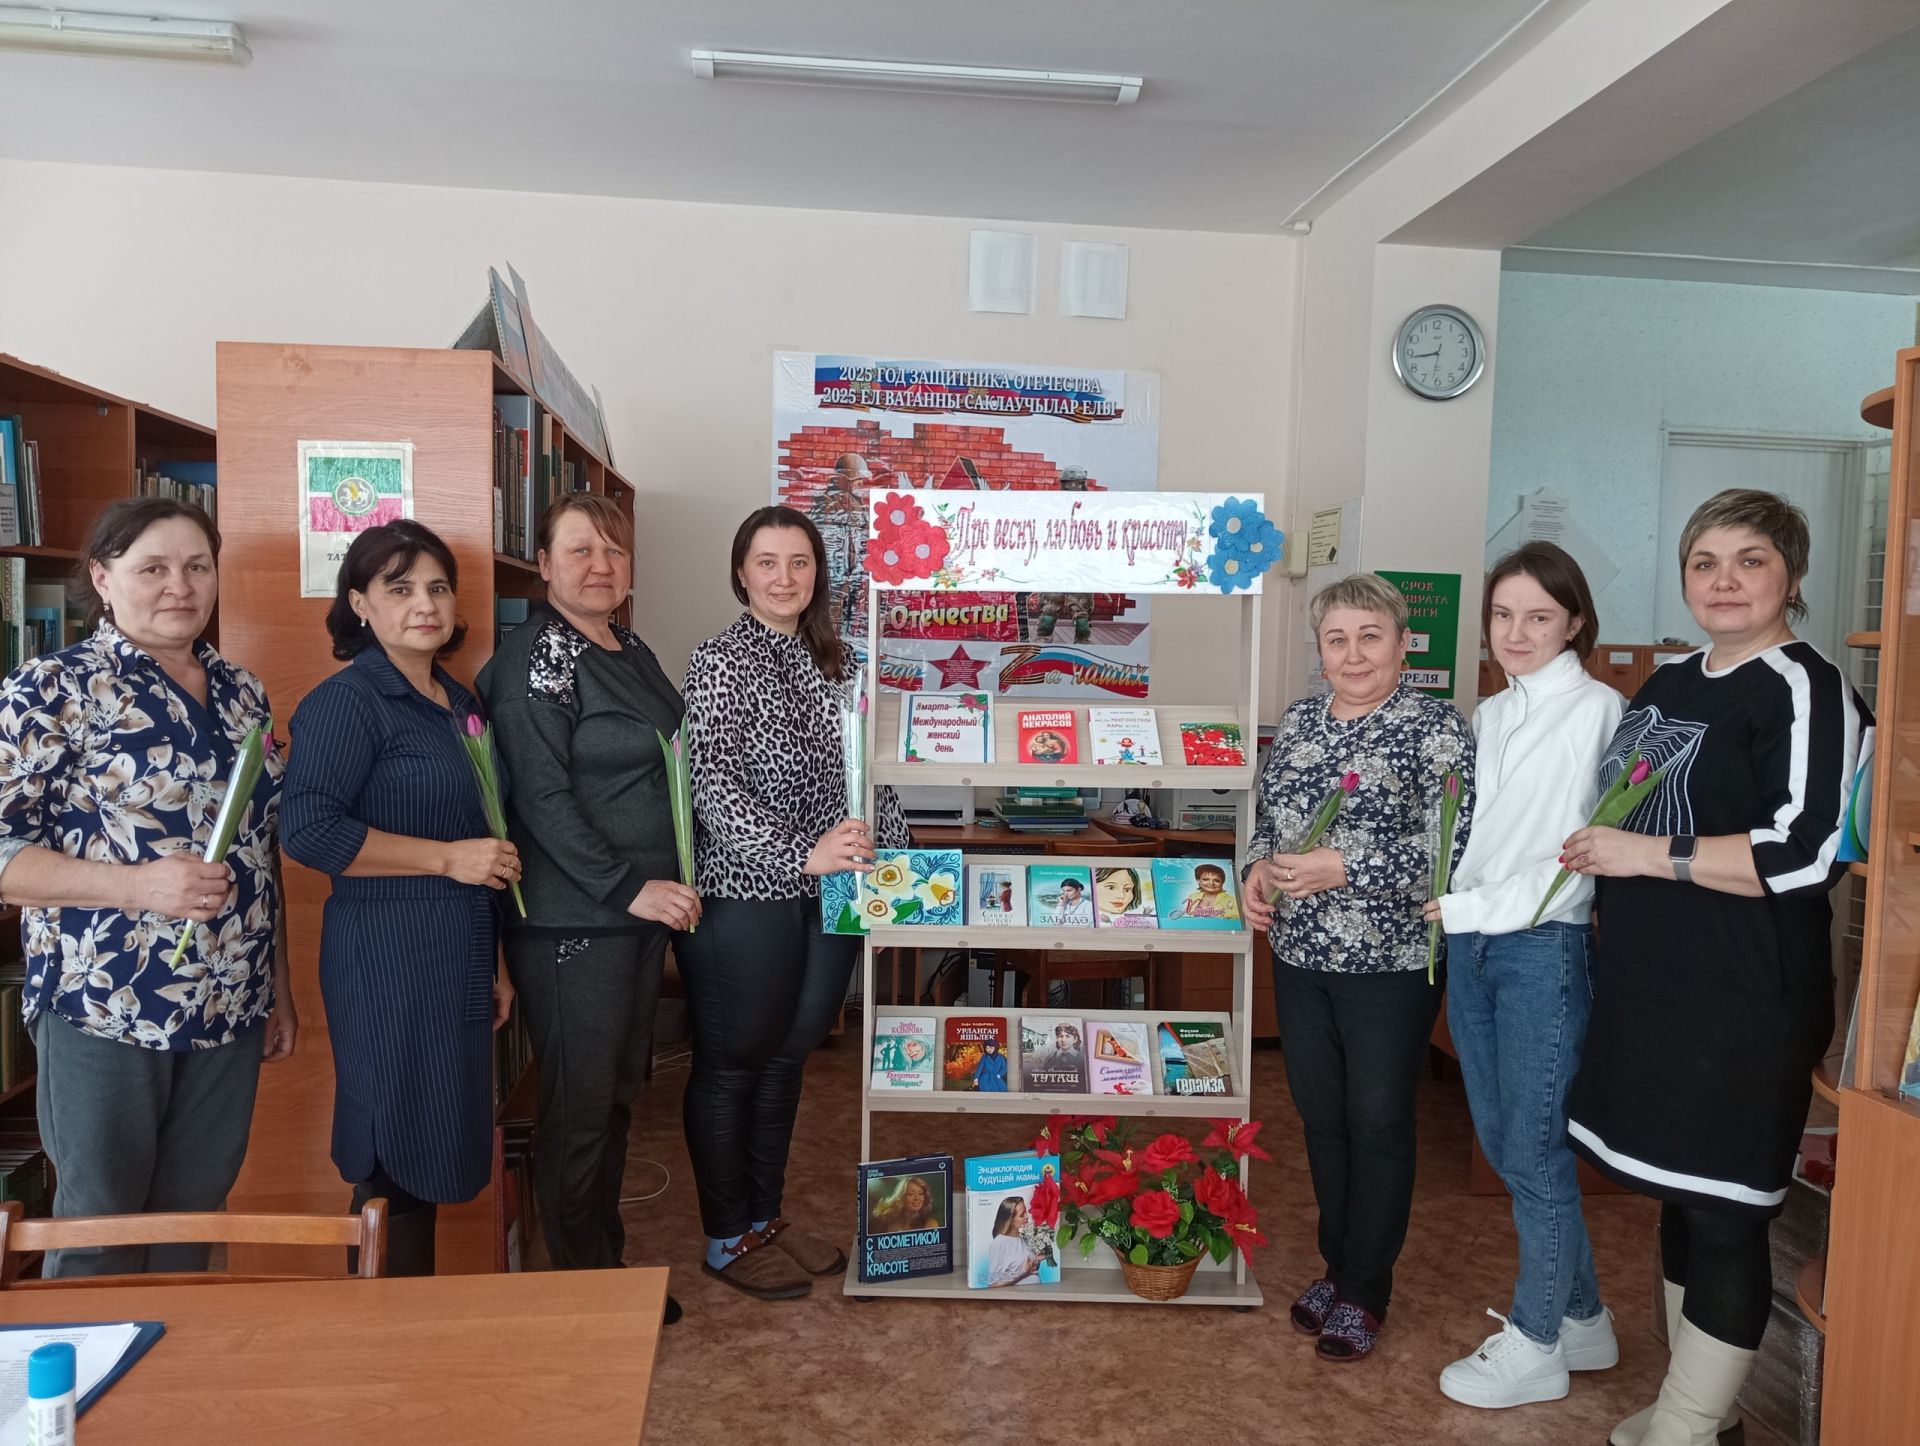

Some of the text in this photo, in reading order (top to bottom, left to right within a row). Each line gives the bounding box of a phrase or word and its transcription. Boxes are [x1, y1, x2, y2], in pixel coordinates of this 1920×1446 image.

[1420, 323, 1427, 333] 11
[1433, 319, 1442, 330] 12
[1408, 334, 1419, 345] 10
[1458, 334, 1465, 344] 2
[1407, 348, 1414, 358] 9
[1461, 348, 1468, 358] 3
[1410, 363, 1418, 373] 8
[1458, 362, 1465, 372] 4
[839, 365, 1102, 393] 2025 ГОД ЗАЩИТНИКА ОТЕЧЕСТВА
[1420, 373, 1428, 383] 7
[1434, 376, 1442, 387] 6
[1448, 372, 1455, 383] 5
[823, 387, 1117, 416] 2025 ЕЛ ВАТАННЫ САКЛАУЧЫЛАР ЕЛЫ
[955, 501, 1188, 567] Про весну, любовь и красоту
[1401, 580, 1435, 591] СРОК
[890, 603, 1009, 630] Отечества
[1070, 661, 1149, 687] наших
[912, 716, 977, 729] Международный
[1022, 712, 1072, 722] АНАТОЛИЙ
[1022, 720, 1073, 729] НЕКРАСОВ
[926, 730, 961, 740] женский
[934, 742, 954, 753] день
[1031, 1073, 1080, 1083] ТУТАШ
[977, 1164, 1033, 1175] Энциклопедия
[978, 1173, 1040, 1186] будущей мамы
[866, 1229, 940, 1251] С КОСМЕТИКОЙ
[866, 1250, 874, 1264] К
[866, 1260, 909, 1277] КРАСОТЕ
